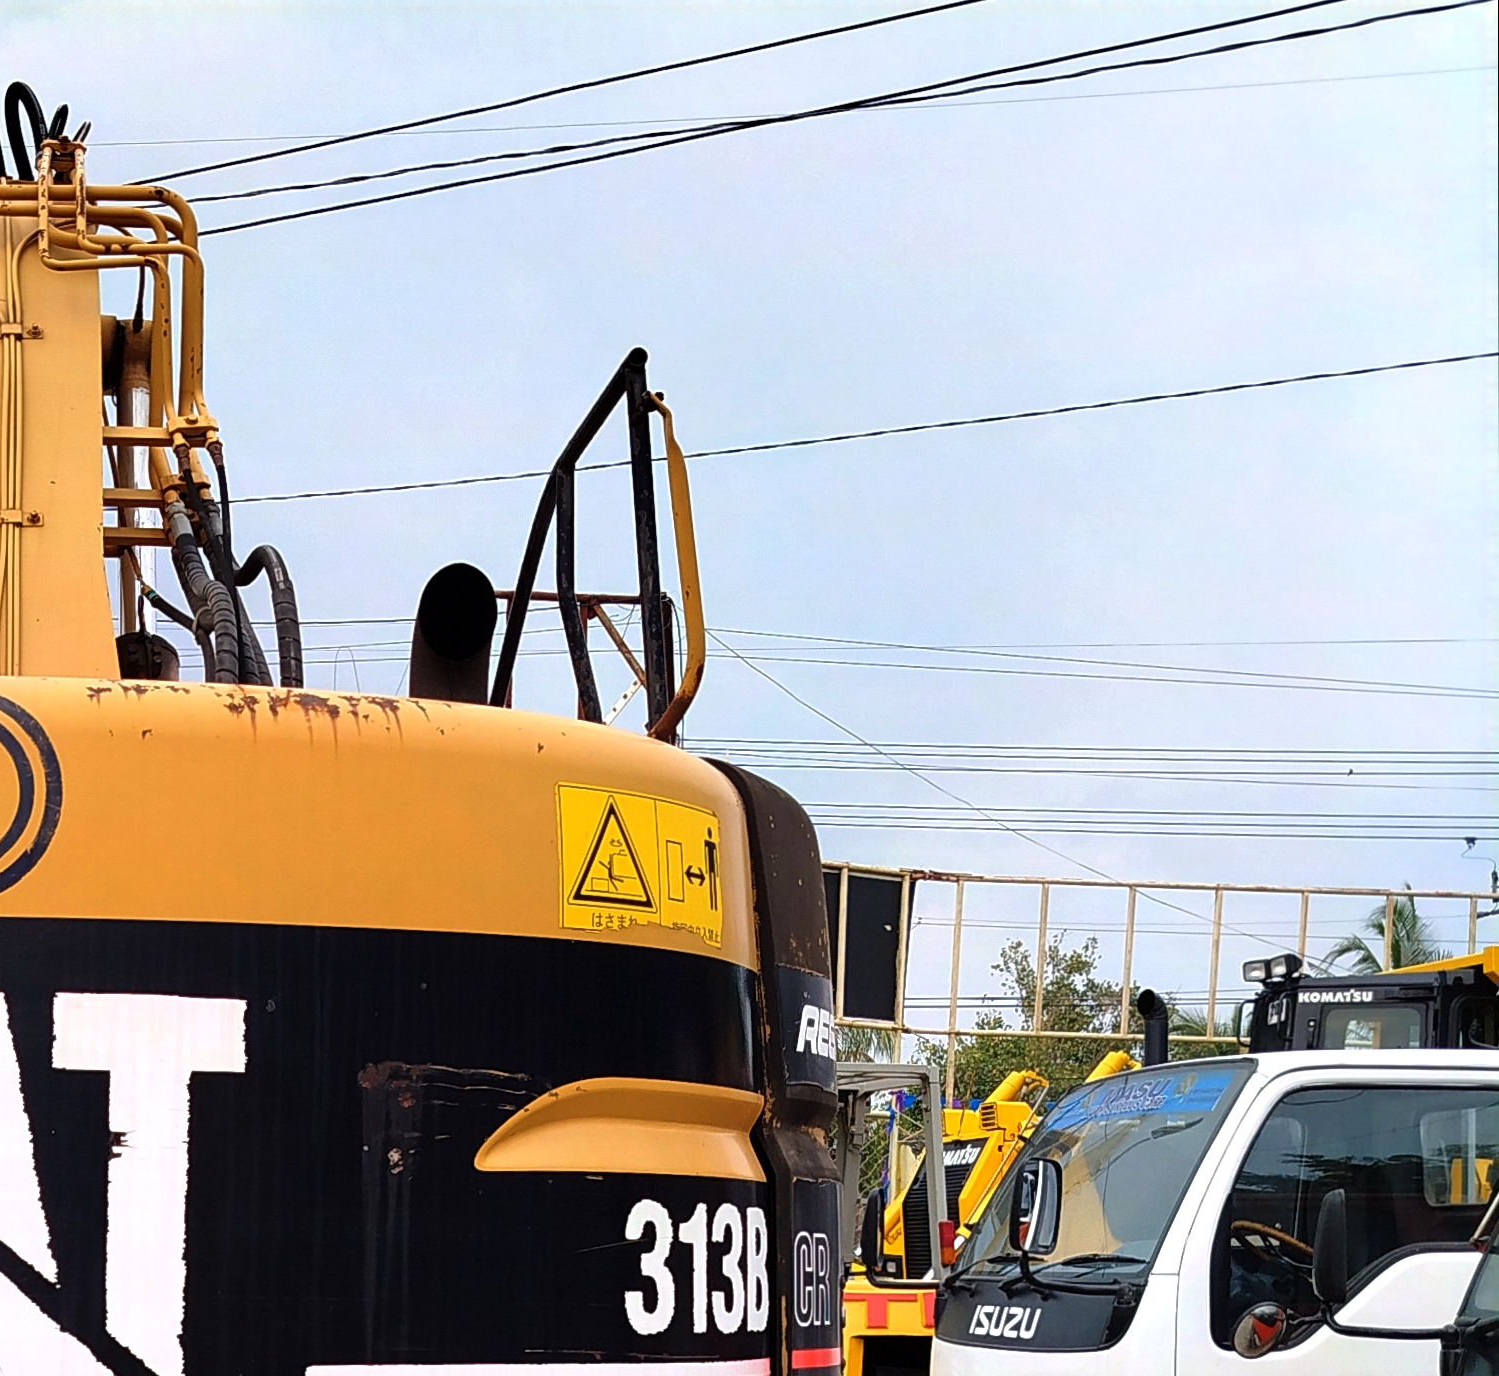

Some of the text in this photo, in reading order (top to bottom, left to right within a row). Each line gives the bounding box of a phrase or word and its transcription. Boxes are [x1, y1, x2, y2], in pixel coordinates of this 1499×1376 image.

[1298, 988, 1373, 1003] KOMATSU
[942, 1143, 982, 1166] MATSU
[624, 1199, 832, 1336] 313B CR
[968, 1304, 1042, 1340] ISUZU
